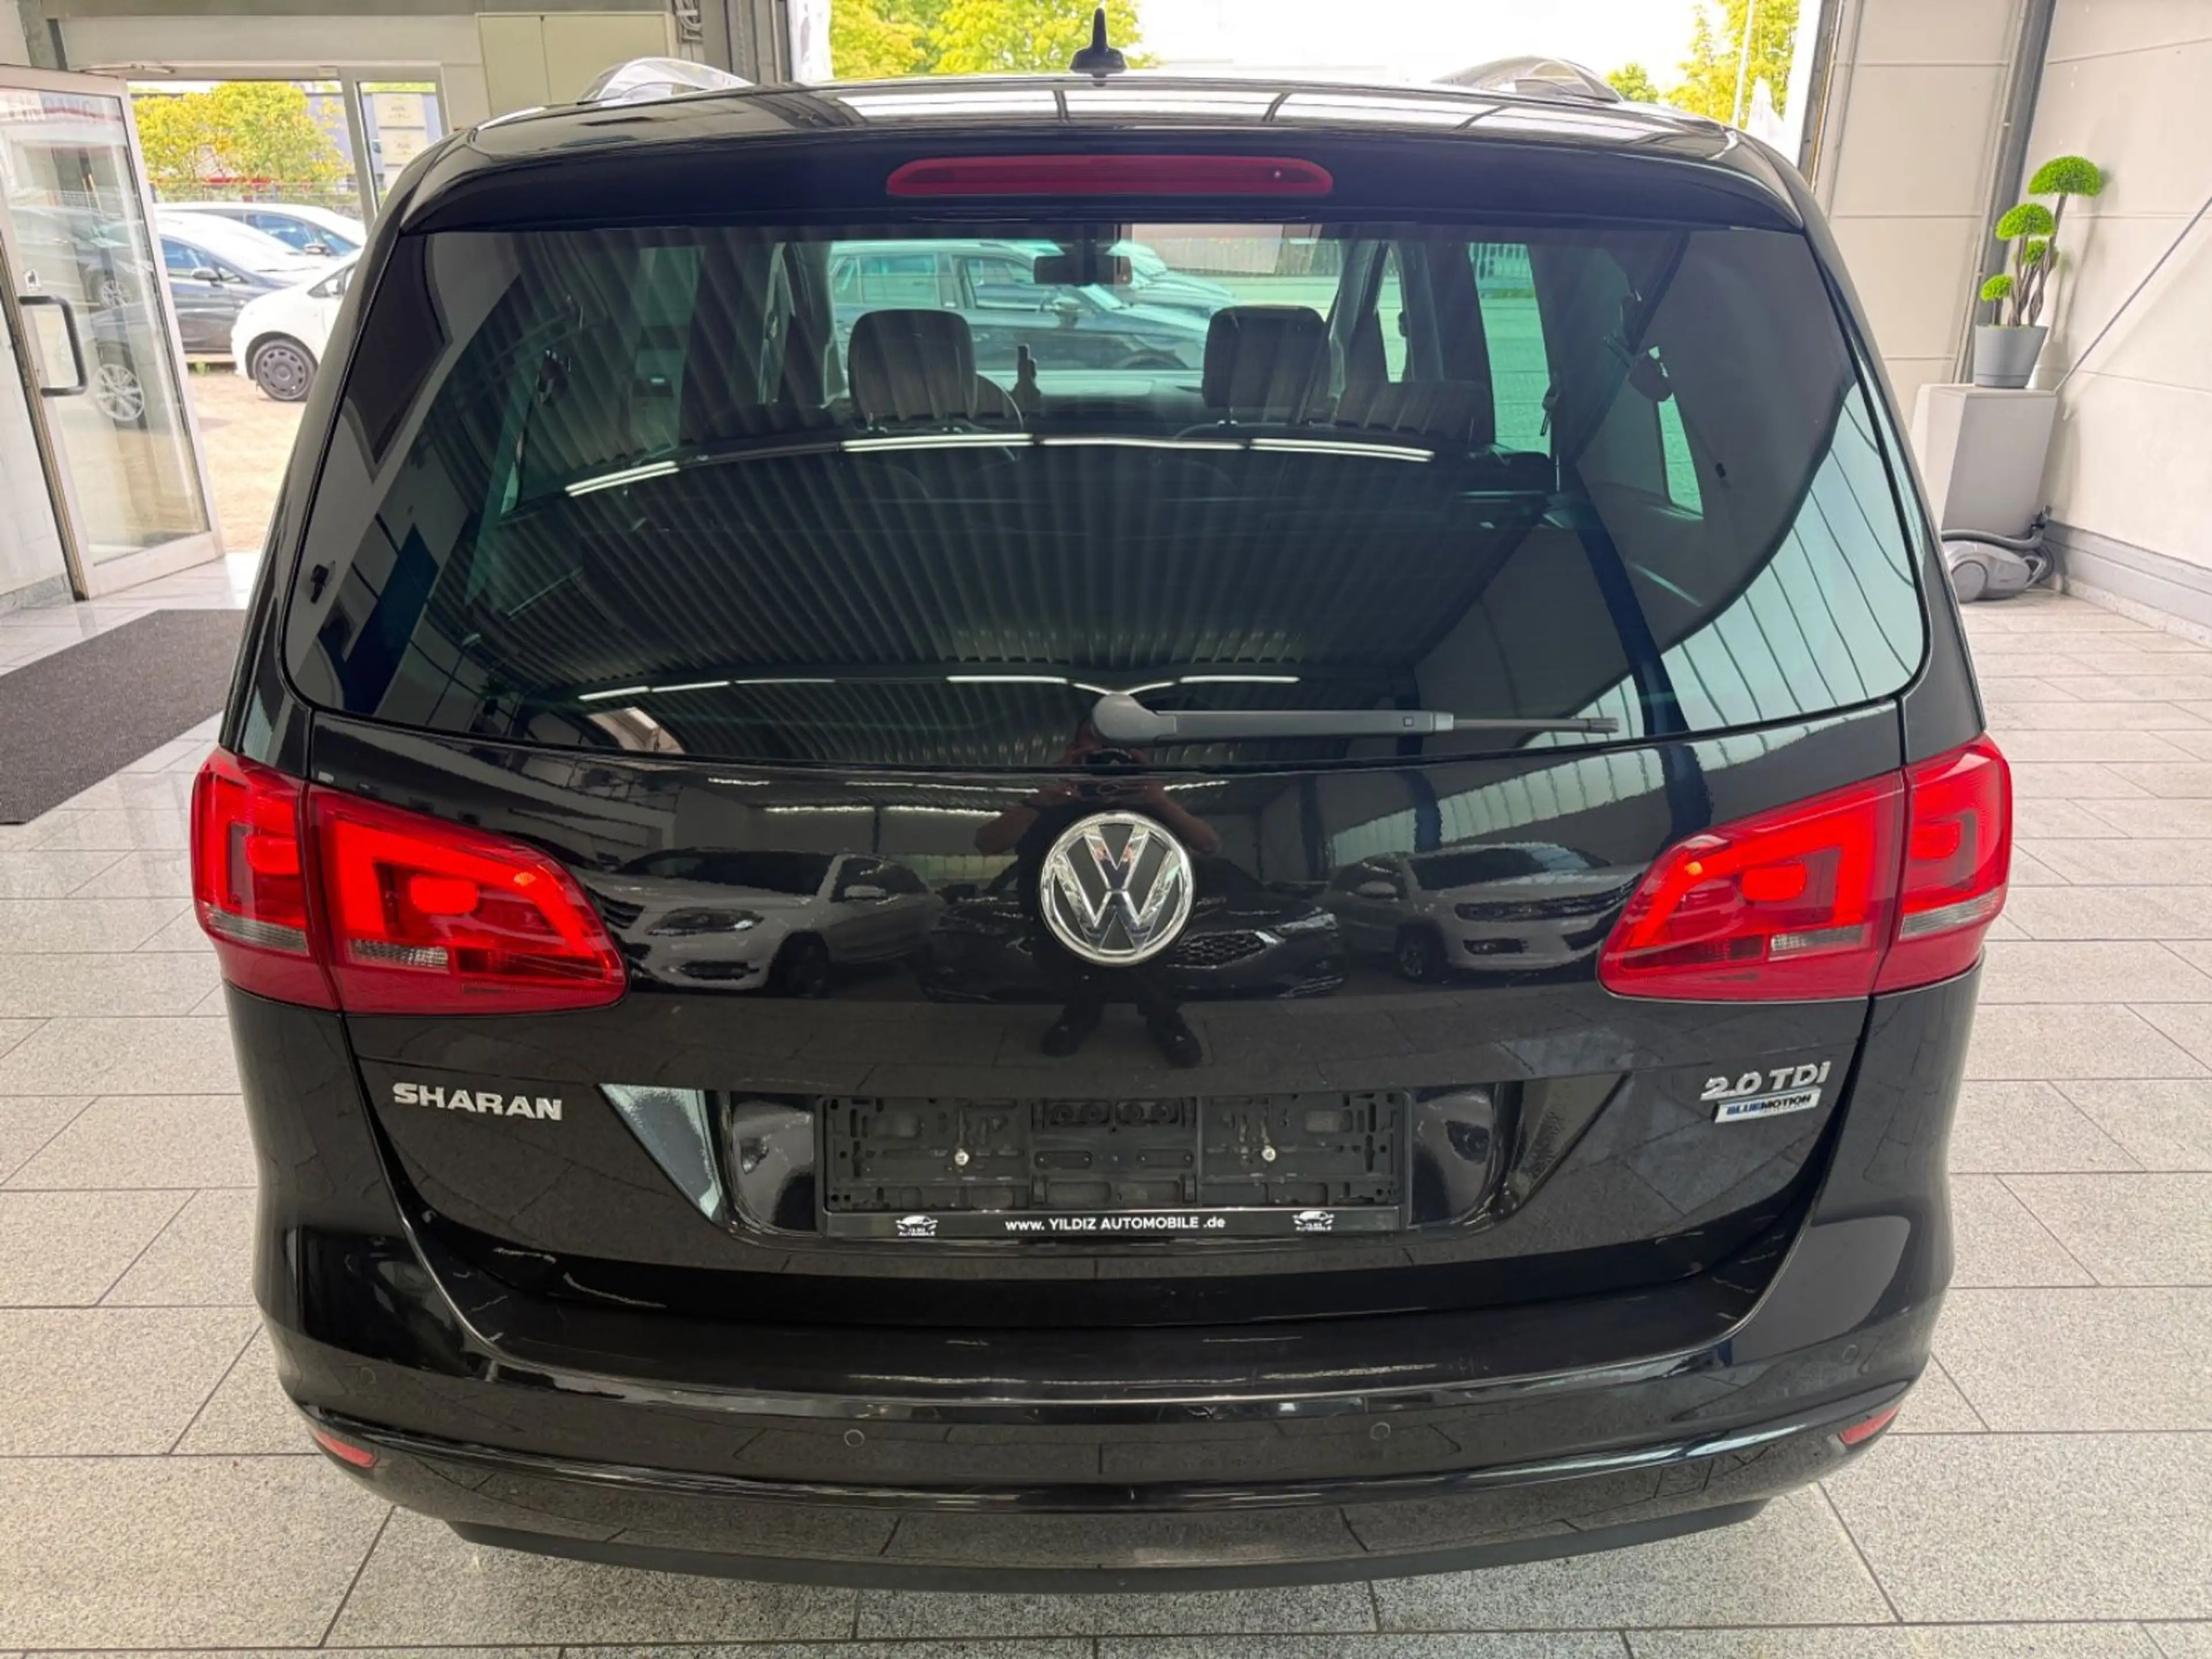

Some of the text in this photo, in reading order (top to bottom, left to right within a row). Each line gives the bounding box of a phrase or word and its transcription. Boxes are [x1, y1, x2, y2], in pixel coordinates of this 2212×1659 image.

[1700, 1062, 1831, 1100] 2.0 TDI
[392, 1082, 563, 1120] SHARAN
[1005, 1215, 1226, 1230] www. YILDIZ AUTOMOBILE .de
